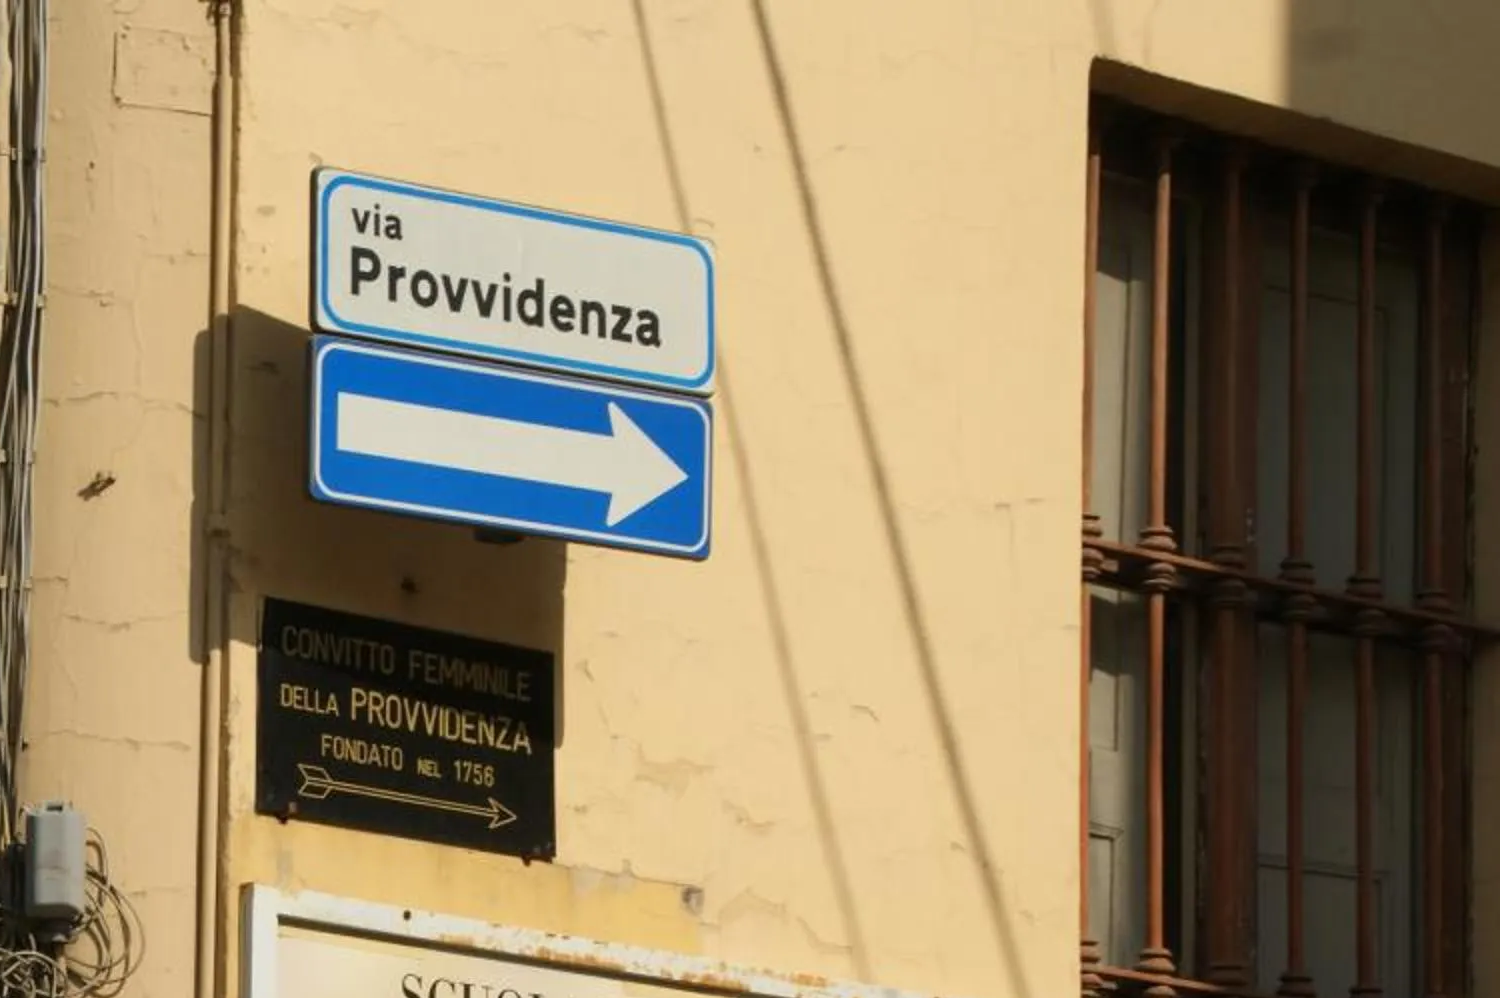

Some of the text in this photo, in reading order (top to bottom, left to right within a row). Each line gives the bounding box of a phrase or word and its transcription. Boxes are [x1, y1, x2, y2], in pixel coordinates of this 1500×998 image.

[351, 203, 403, 241] via
[349, 246, 662, 349] Provvidenza
[281, 625, 533, 702] CONVITTO FEMMINILE
[280, 683, 533, 755] DELLA PROVVIDENZA
[320, 733, 496, 788] FONDATO NEL 1756
